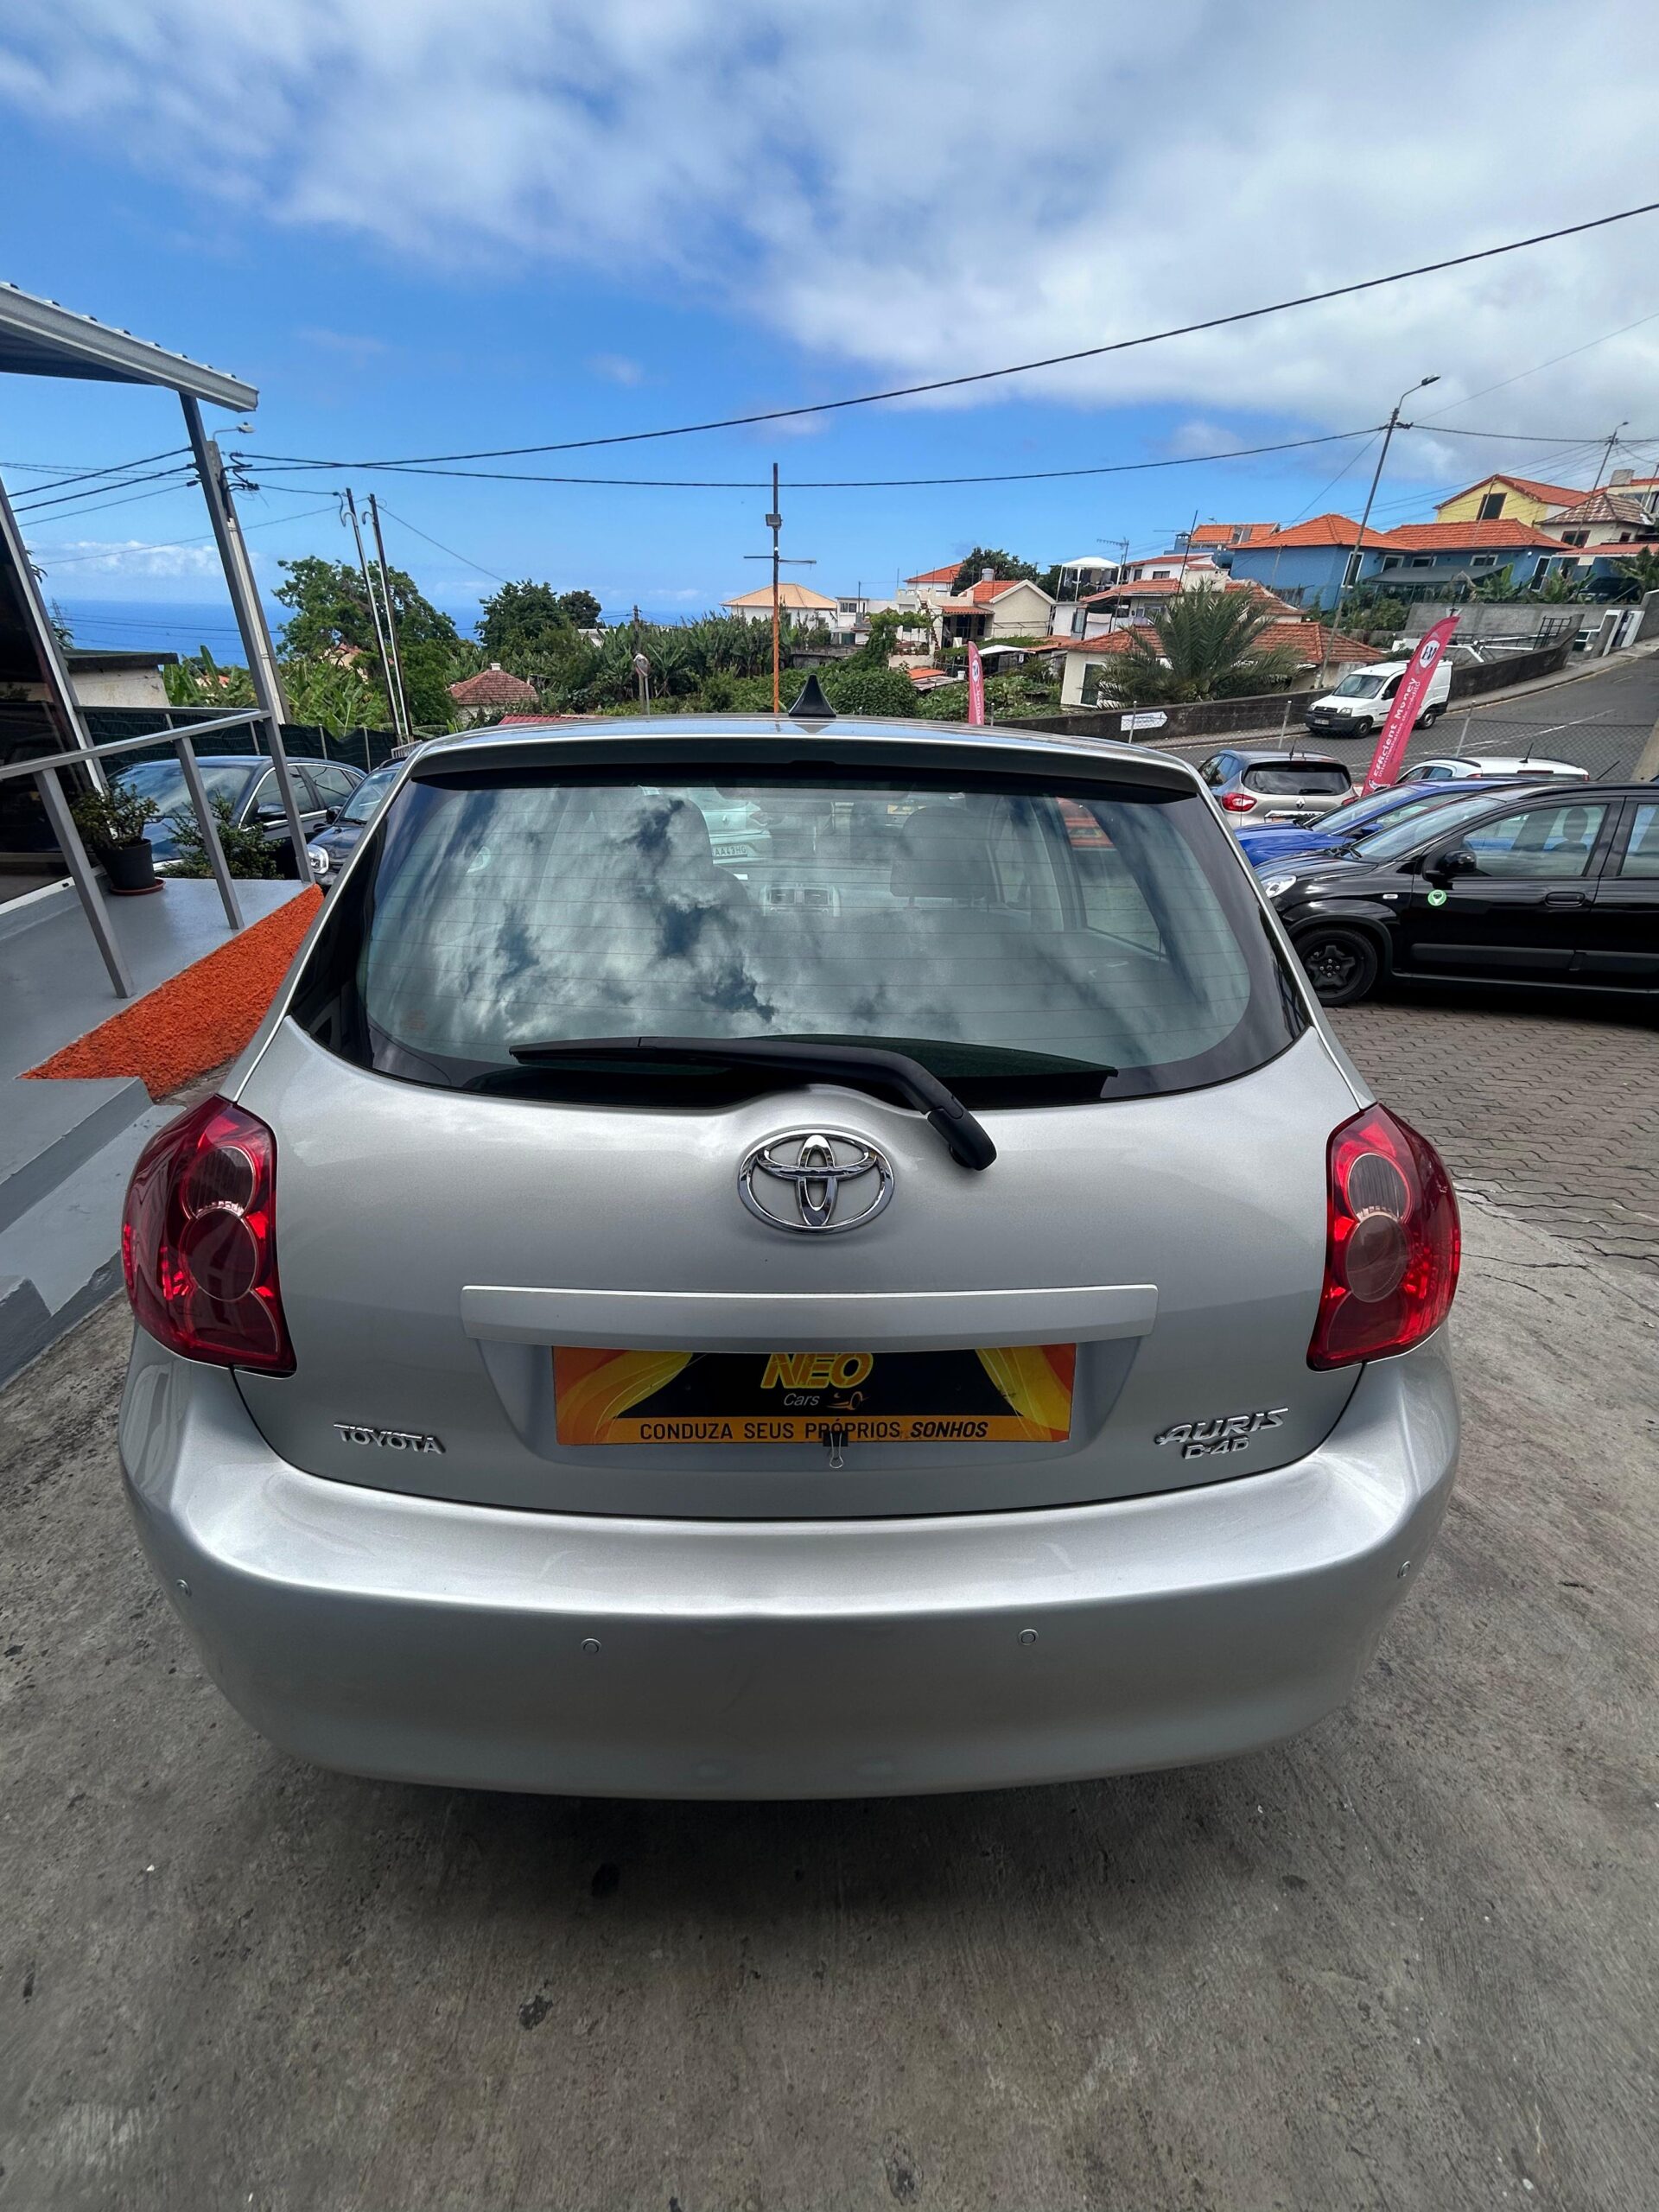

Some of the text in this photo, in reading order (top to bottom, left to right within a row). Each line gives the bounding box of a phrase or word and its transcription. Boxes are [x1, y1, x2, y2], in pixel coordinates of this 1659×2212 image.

[1395, 677, 1417, 719] Money
[760, 1353, 874, 1389] NEO
[784, 1393, 820, 1406] Cars
[334, 1422, 446, 1454] TOYOTA
[640, 1423, 733, 1440] CONDUZA
[744, 1422, 794, 1439] SEUS
[910, 1421, 988, 1438] SONHOS
[1154, 1407, 1289, 1446] AURIS
